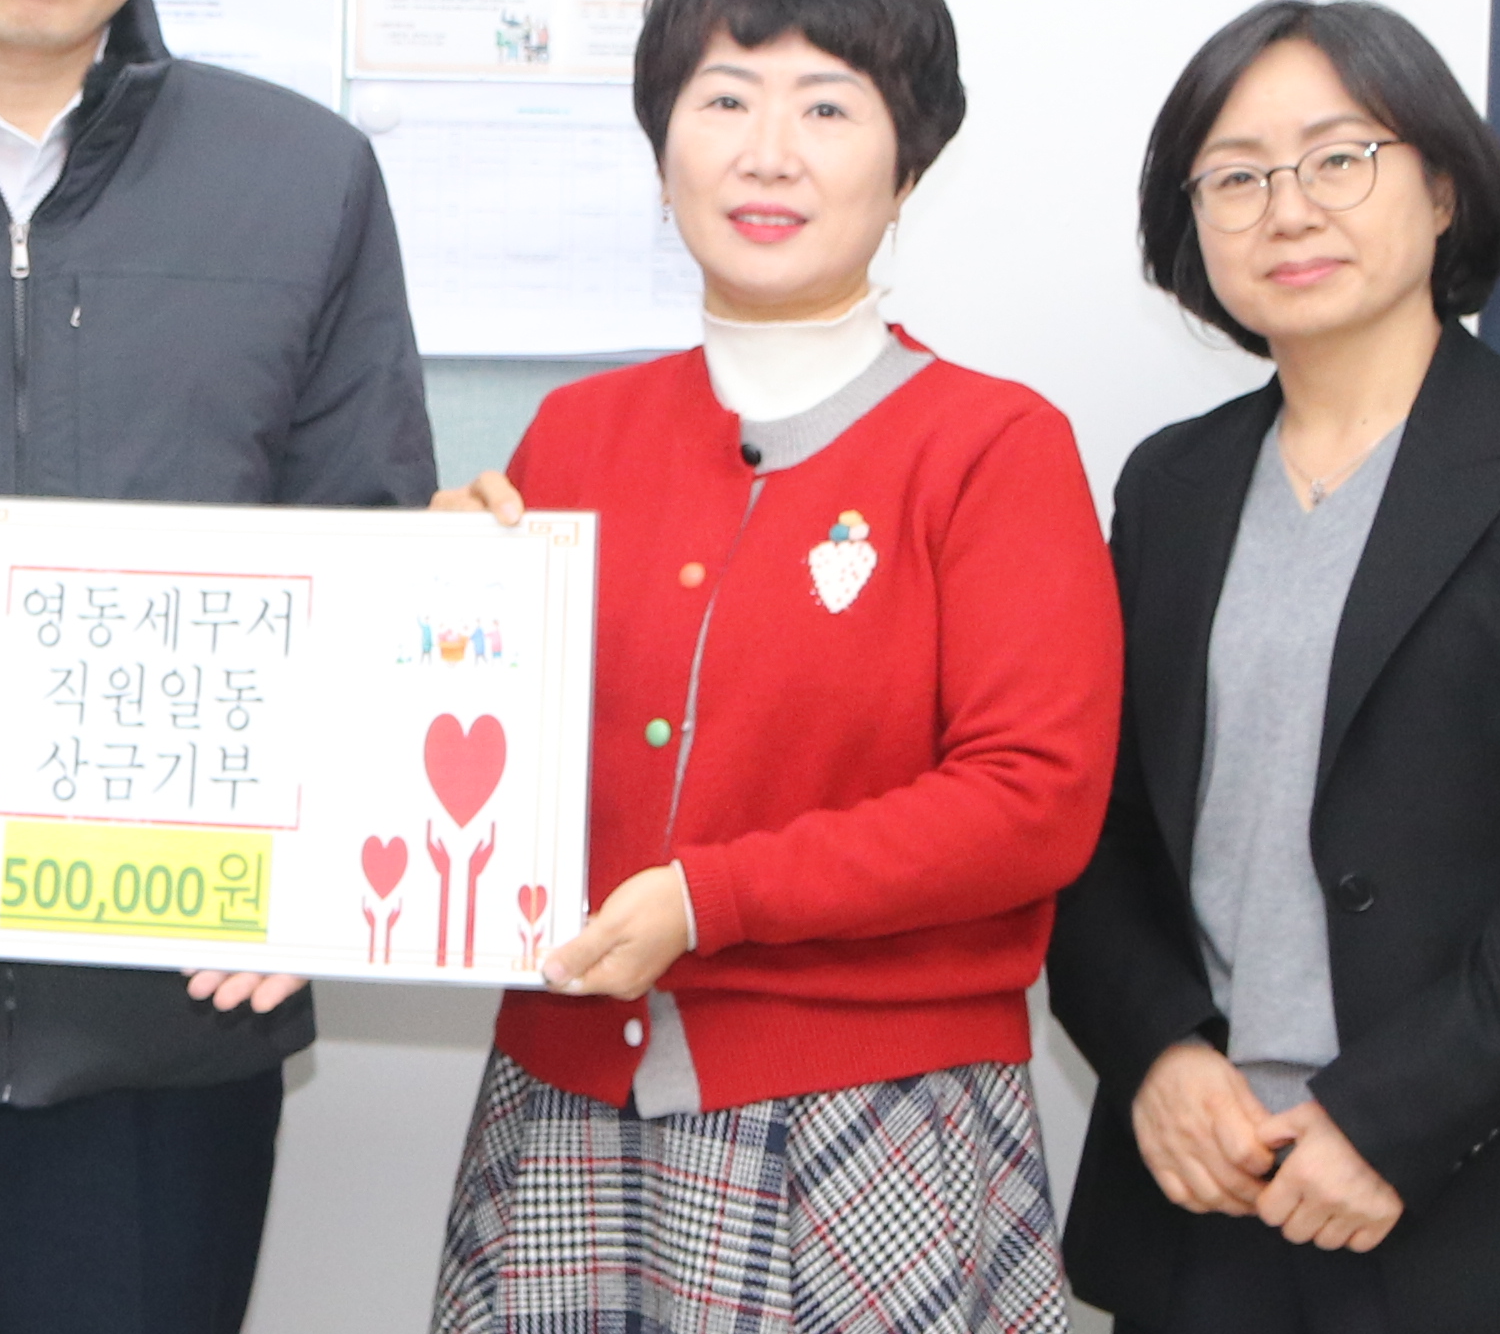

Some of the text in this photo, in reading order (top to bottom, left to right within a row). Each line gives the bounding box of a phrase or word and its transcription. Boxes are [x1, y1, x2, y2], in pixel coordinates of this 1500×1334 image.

[22, 579, 296, 659] 영동세무서
[43, 660, 265, 733] 직원일동
[36, 735, 261, 810] 상금기부
[0, 850, 265, 927] 500,000원
